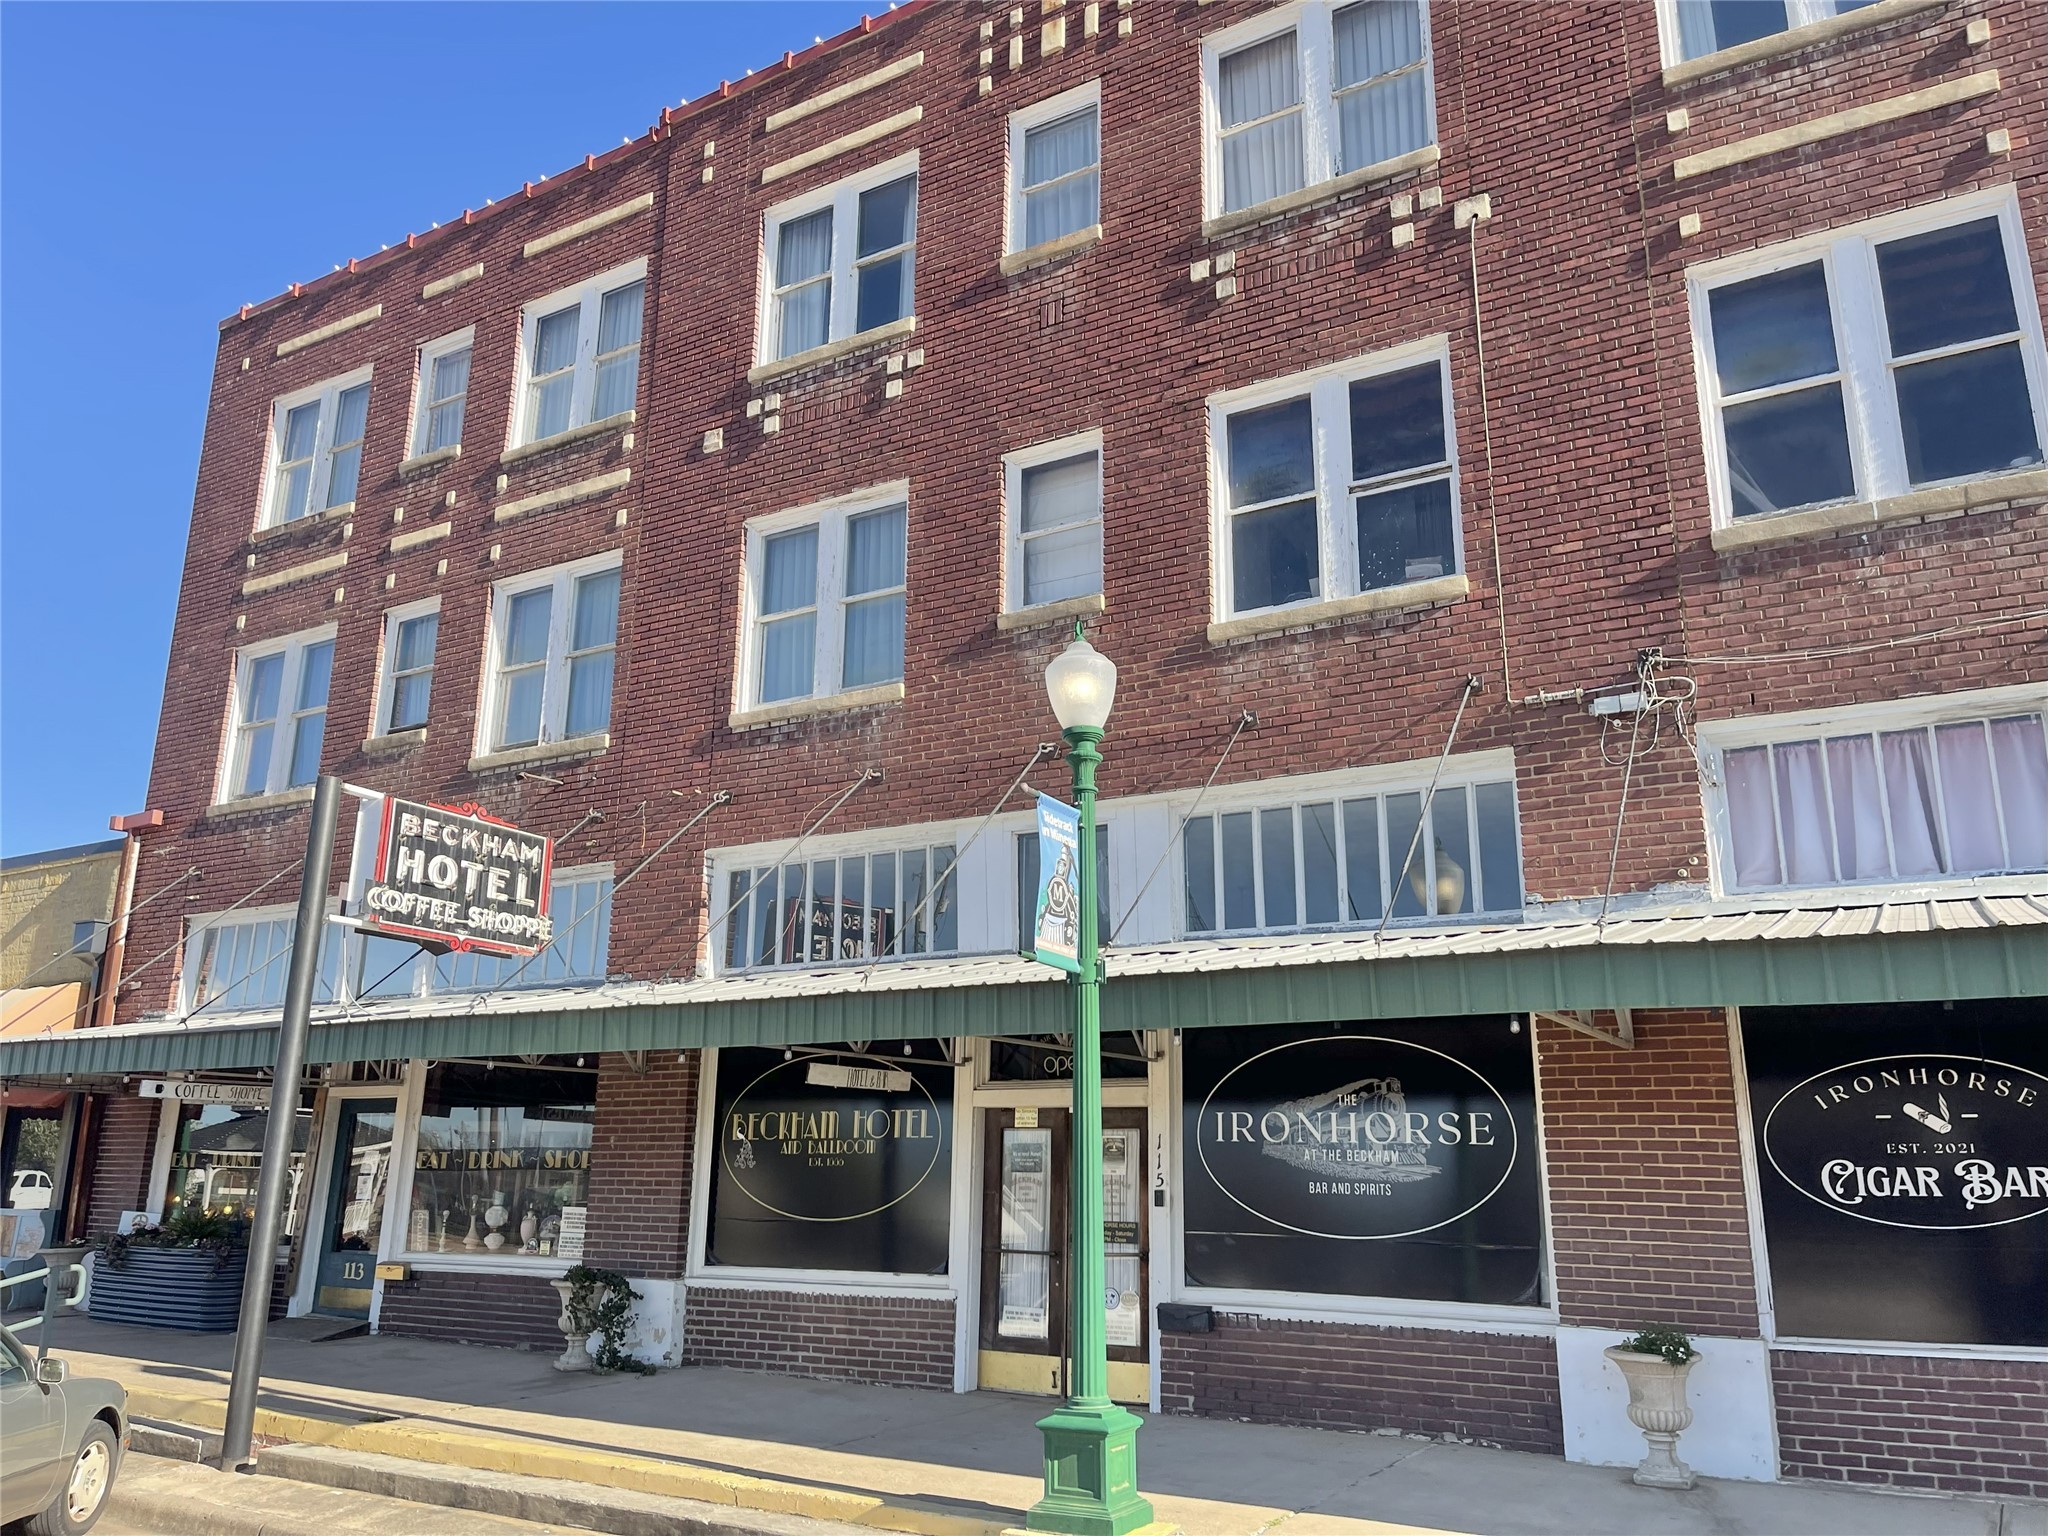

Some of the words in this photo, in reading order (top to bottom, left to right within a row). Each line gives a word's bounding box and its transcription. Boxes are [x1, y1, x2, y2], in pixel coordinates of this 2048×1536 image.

[401, 813, 542, 867] BECKHAM
[397, 846, 535, 908] HOTEL
[1052, 883, 1064, 903] M
[367, 886, 461, 924] COFFEE
[468, 906, 553, 941] SHOPPE
[175, 1083, 222, 1099] COFFEE
[228, 1086, 266, 1101] SHOPPE
[1814, 1067, 2038, 1110] IRONHORSE
[1337, 1094, 1357, 1107] THE
[732, 1110, 840, 1141] BECKHAM
[853, 1109, 933, 1140] HOTEL
[1215, 1111, 1495, 1146] IRONHORSE
[781, 1141, 802, 1155] AND
[808, 1139, 876, 1155] BALLROOM
[1303, 1149, 1319, 1161] AT
[1322, 1149, 1342, 1162] THE
[1347, 1150, 1399, 1163] BECKHAM
[1886, 1143, 1927, 1154] EST.
[1934, 1143, 1975, 1154] 2021
[170, 1152, 198, 1168] EAT
[417, 1151, 450, 1169] EAT
[468, 1150, 524, 1169] DRINK
[287, 1111, 320, 1274] ANTIQUES
[1309, 1182, 1328, 1194] BAR
[1332, 1182, 1351, 1195] AND
[1354, 1183, 1392, 1196] SPIRITS
[1820, 1159, 1943, 1205] CIGAR
[1954, 1159, 2048, 1210] BAR
[343, 1262, 364, 1280] 113
